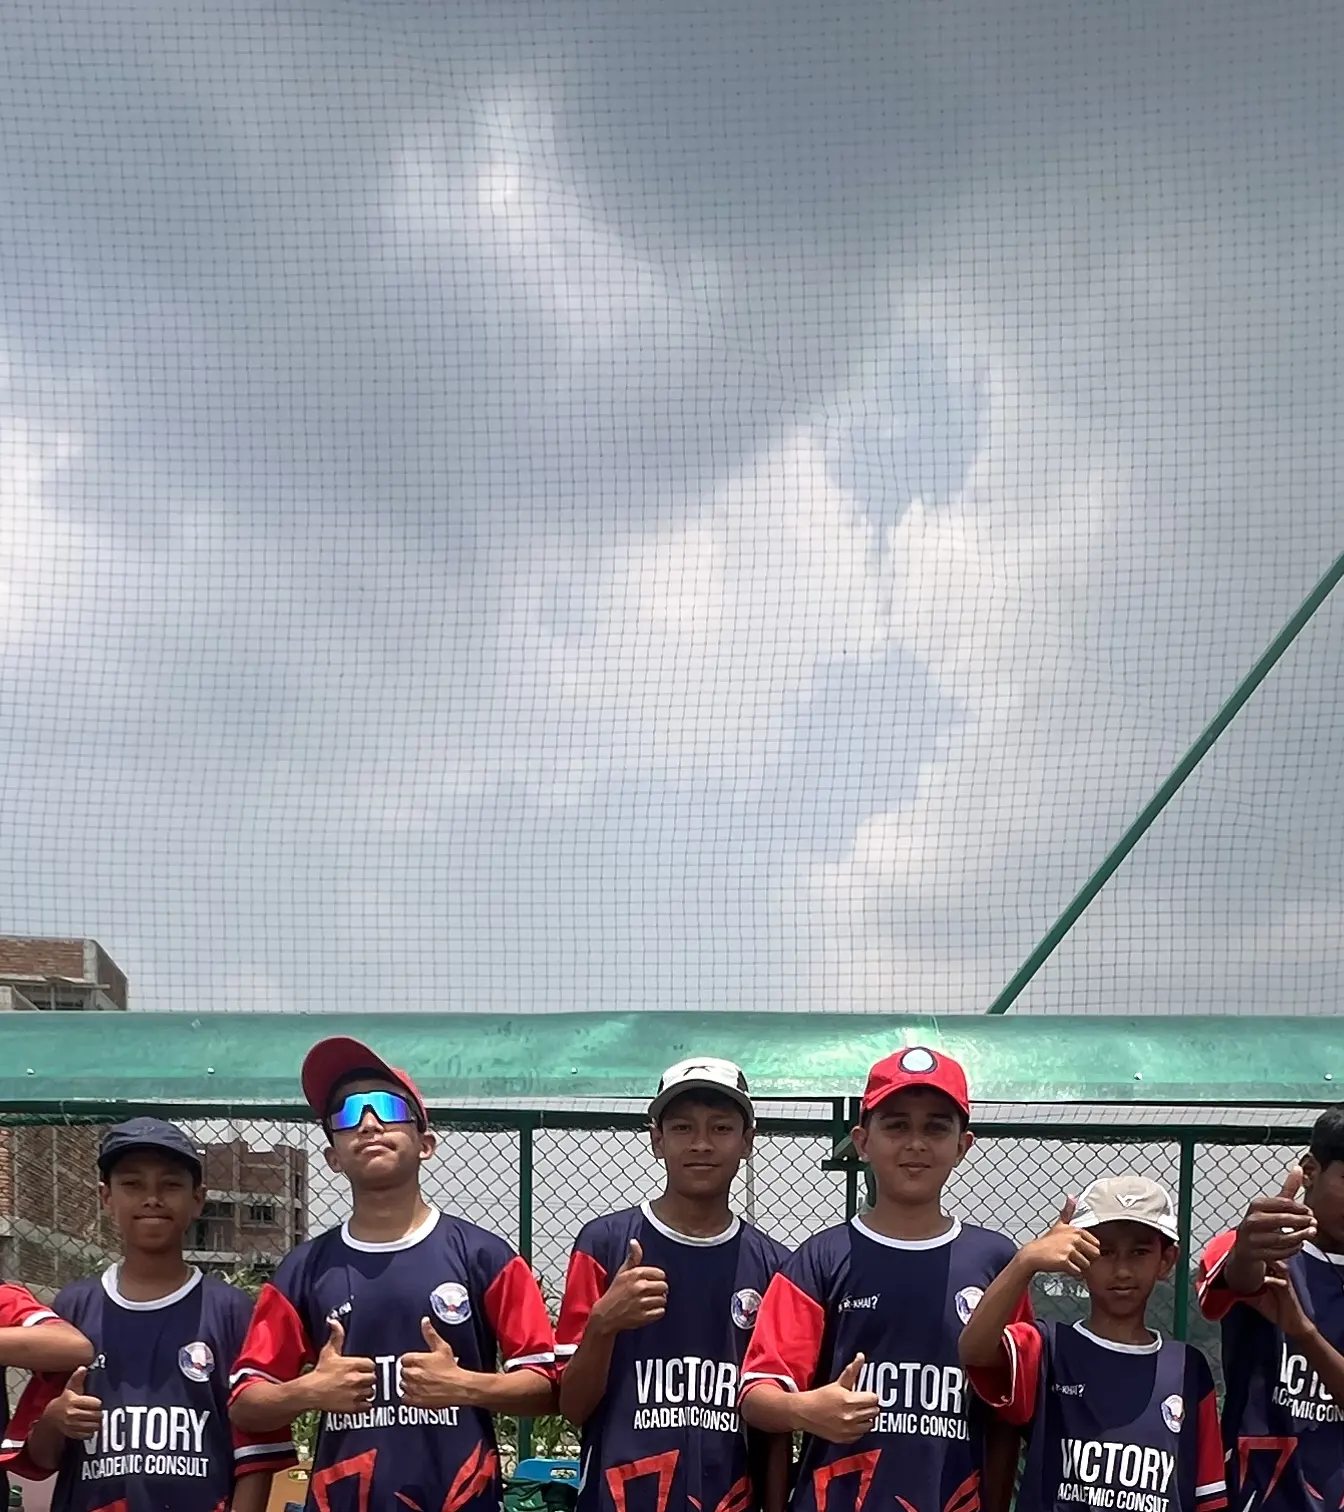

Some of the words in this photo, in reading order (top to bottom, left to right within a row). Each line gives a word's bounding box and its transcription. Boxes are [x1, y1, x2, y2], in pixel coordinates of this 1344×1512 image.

[634, 1356, 740, 1408] VICTOR
[853, 1361, 968, 1414] VICTOR
[325, 1404, 396, 1432] ACADEMIC
[398, 1404, 460, 1428] CONSULT
[920, 1416, 971, 1441] CONSU
[81, 1454, 143, 1481] ACADEMIC
[144, 1454, 209, 1478] CONSULT
[1061, 1438, 1176, 1494] VICTORY
